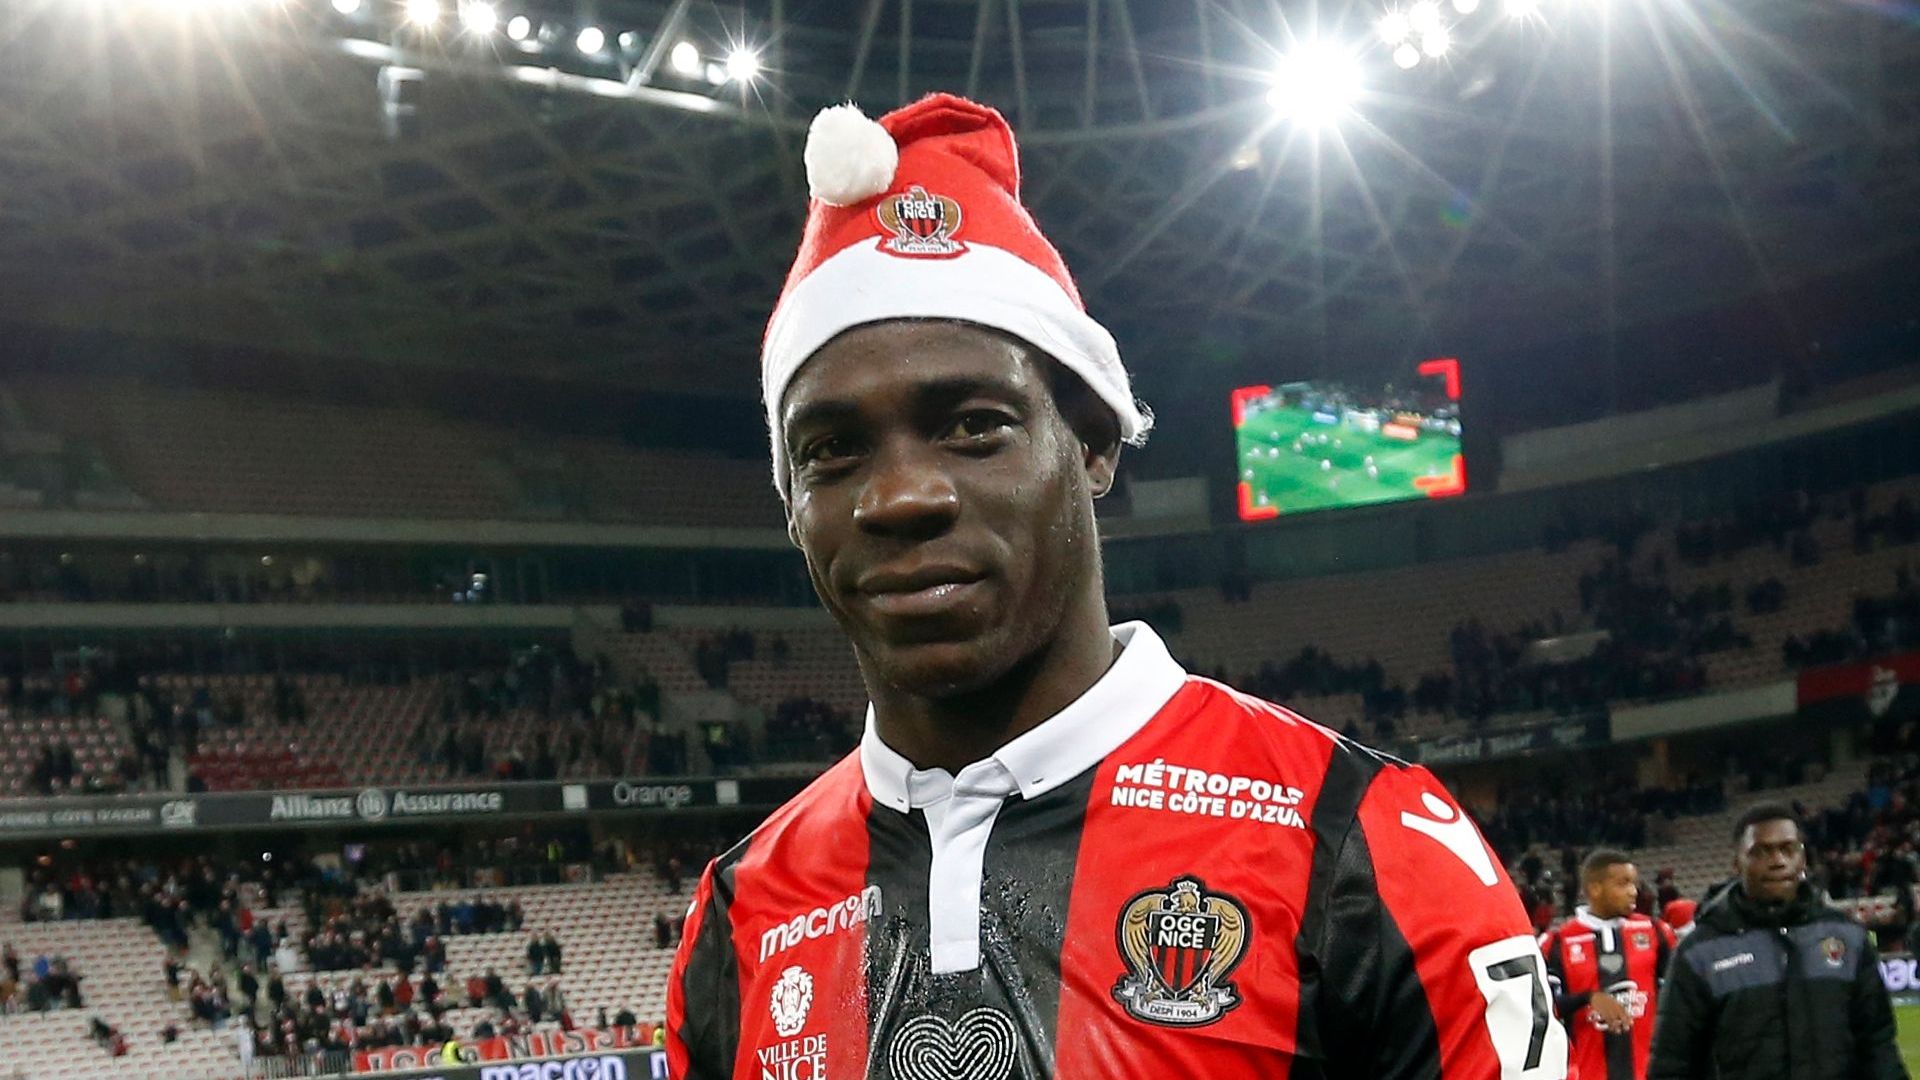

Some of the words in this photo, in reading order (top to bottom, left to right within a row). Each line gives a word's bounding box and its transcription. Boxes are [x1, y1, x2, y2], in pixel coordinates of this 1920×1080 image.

[904, 208, 936, 219] NICE
[270, 795, 351, 818] Allianz
[392, 790, 503, 815] Assurance
[614, 780, 692, 808] Orange
[1111, 786, 1165, 810] NICE
[1168, 790, 1226, 817] CÔTE
[760, 884, 884, 964] macron
[1160, 915, 1207, 933] OGC
[1157, 930, 1205, 949] NICE
[1486, 953, 1550, 1073] 7
[757, 1040, 800, 1066] VILLE
[803, 1033, 827, 1056] DE
[762, 1052, 827, 1080] NICE
